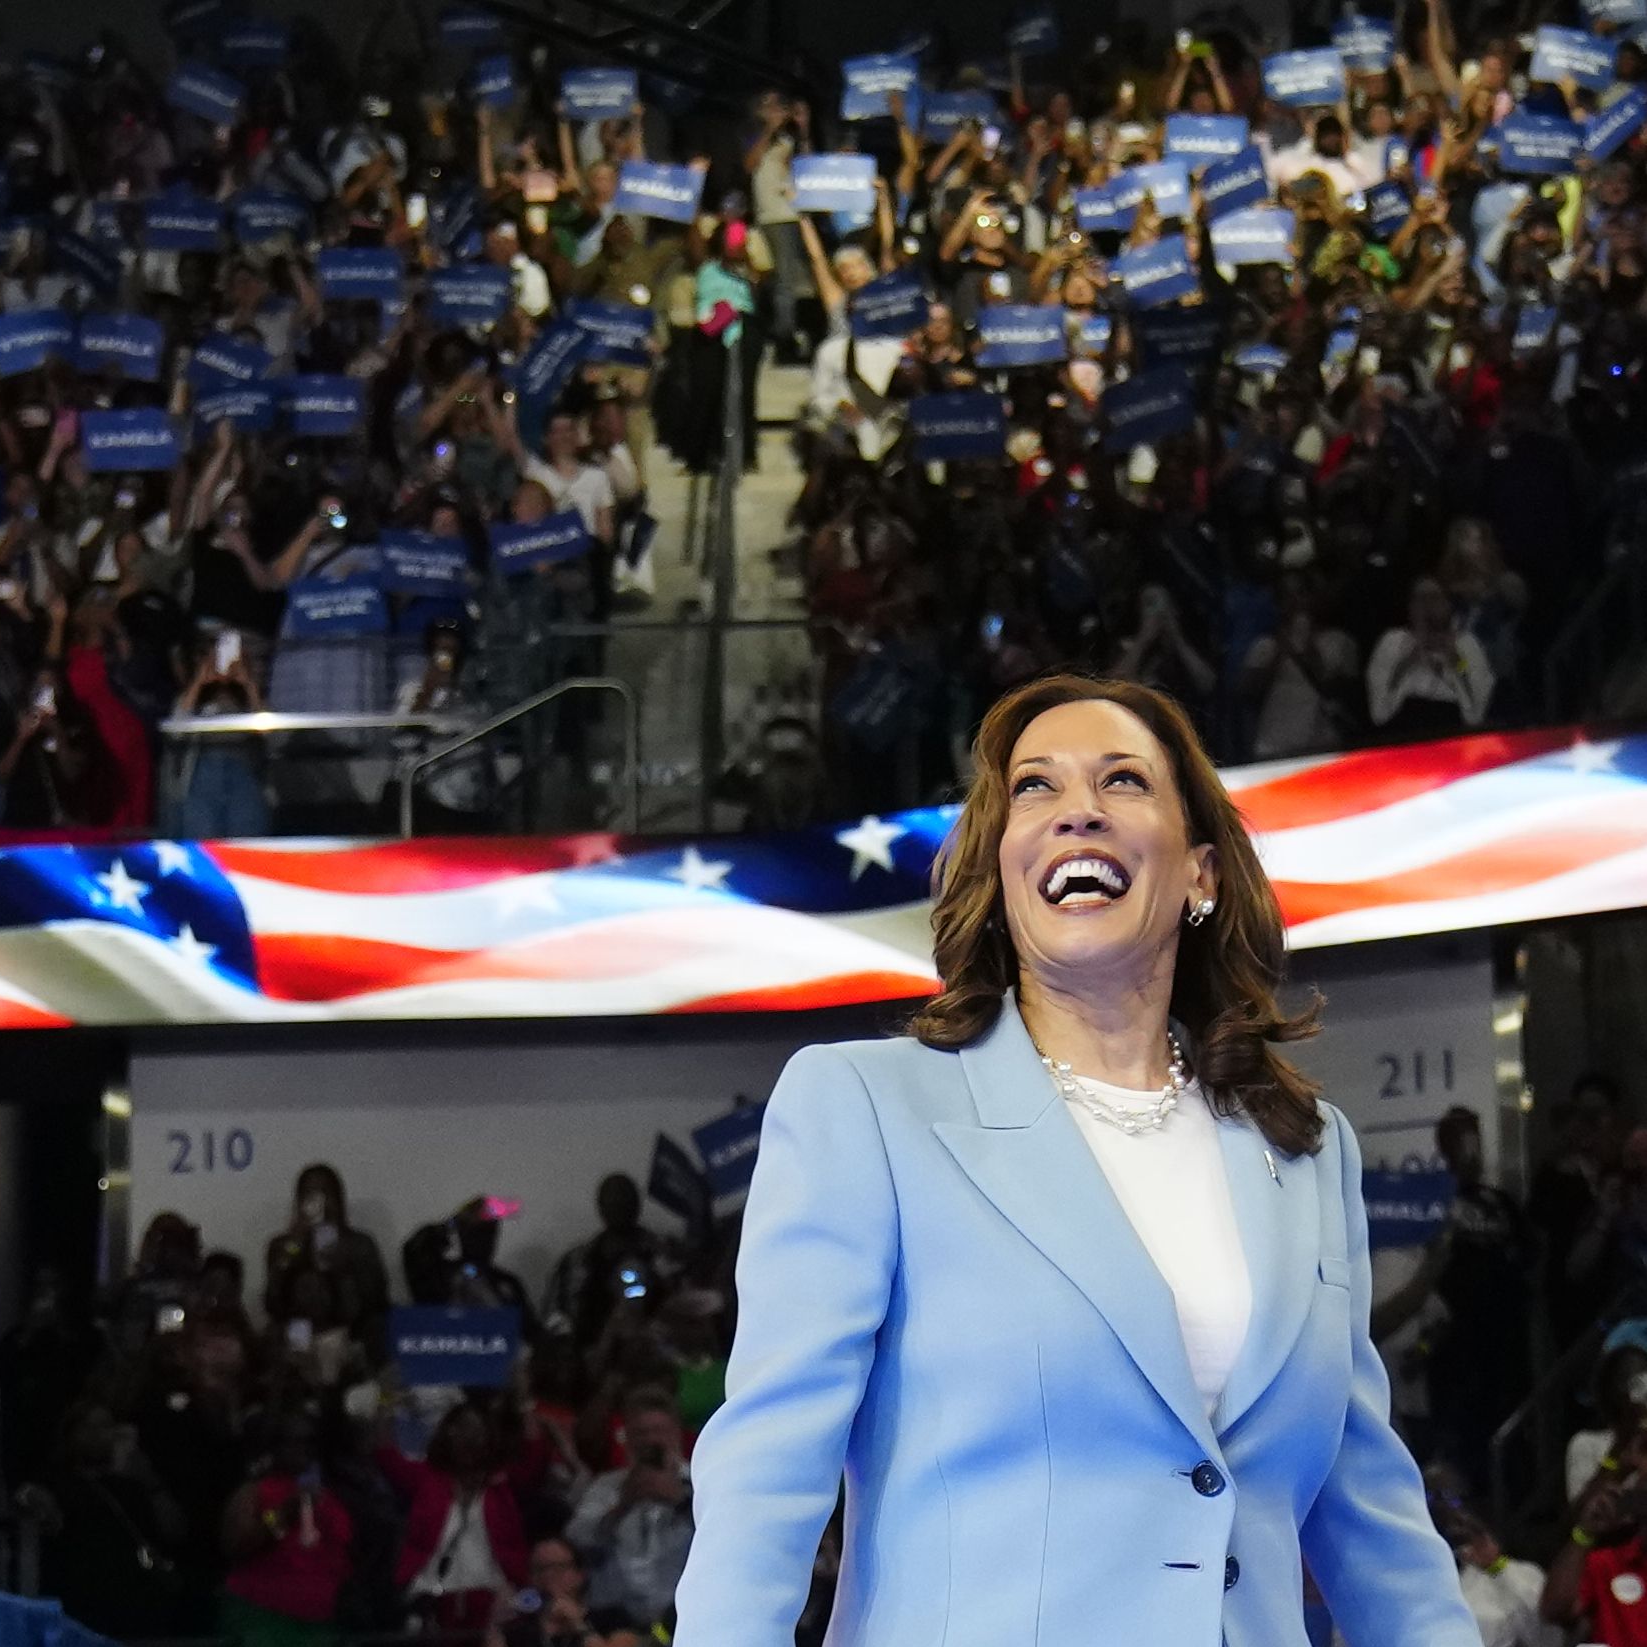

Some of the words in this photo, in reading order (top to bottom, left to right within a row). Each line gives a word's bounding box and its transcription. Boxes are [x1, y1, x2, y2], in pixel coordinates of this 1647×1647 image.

[1379, 1048, 1454, 1100] 211
[166, 1129, 254, 1173] 210
[397, 1334, 509, 1356] KAMALA
